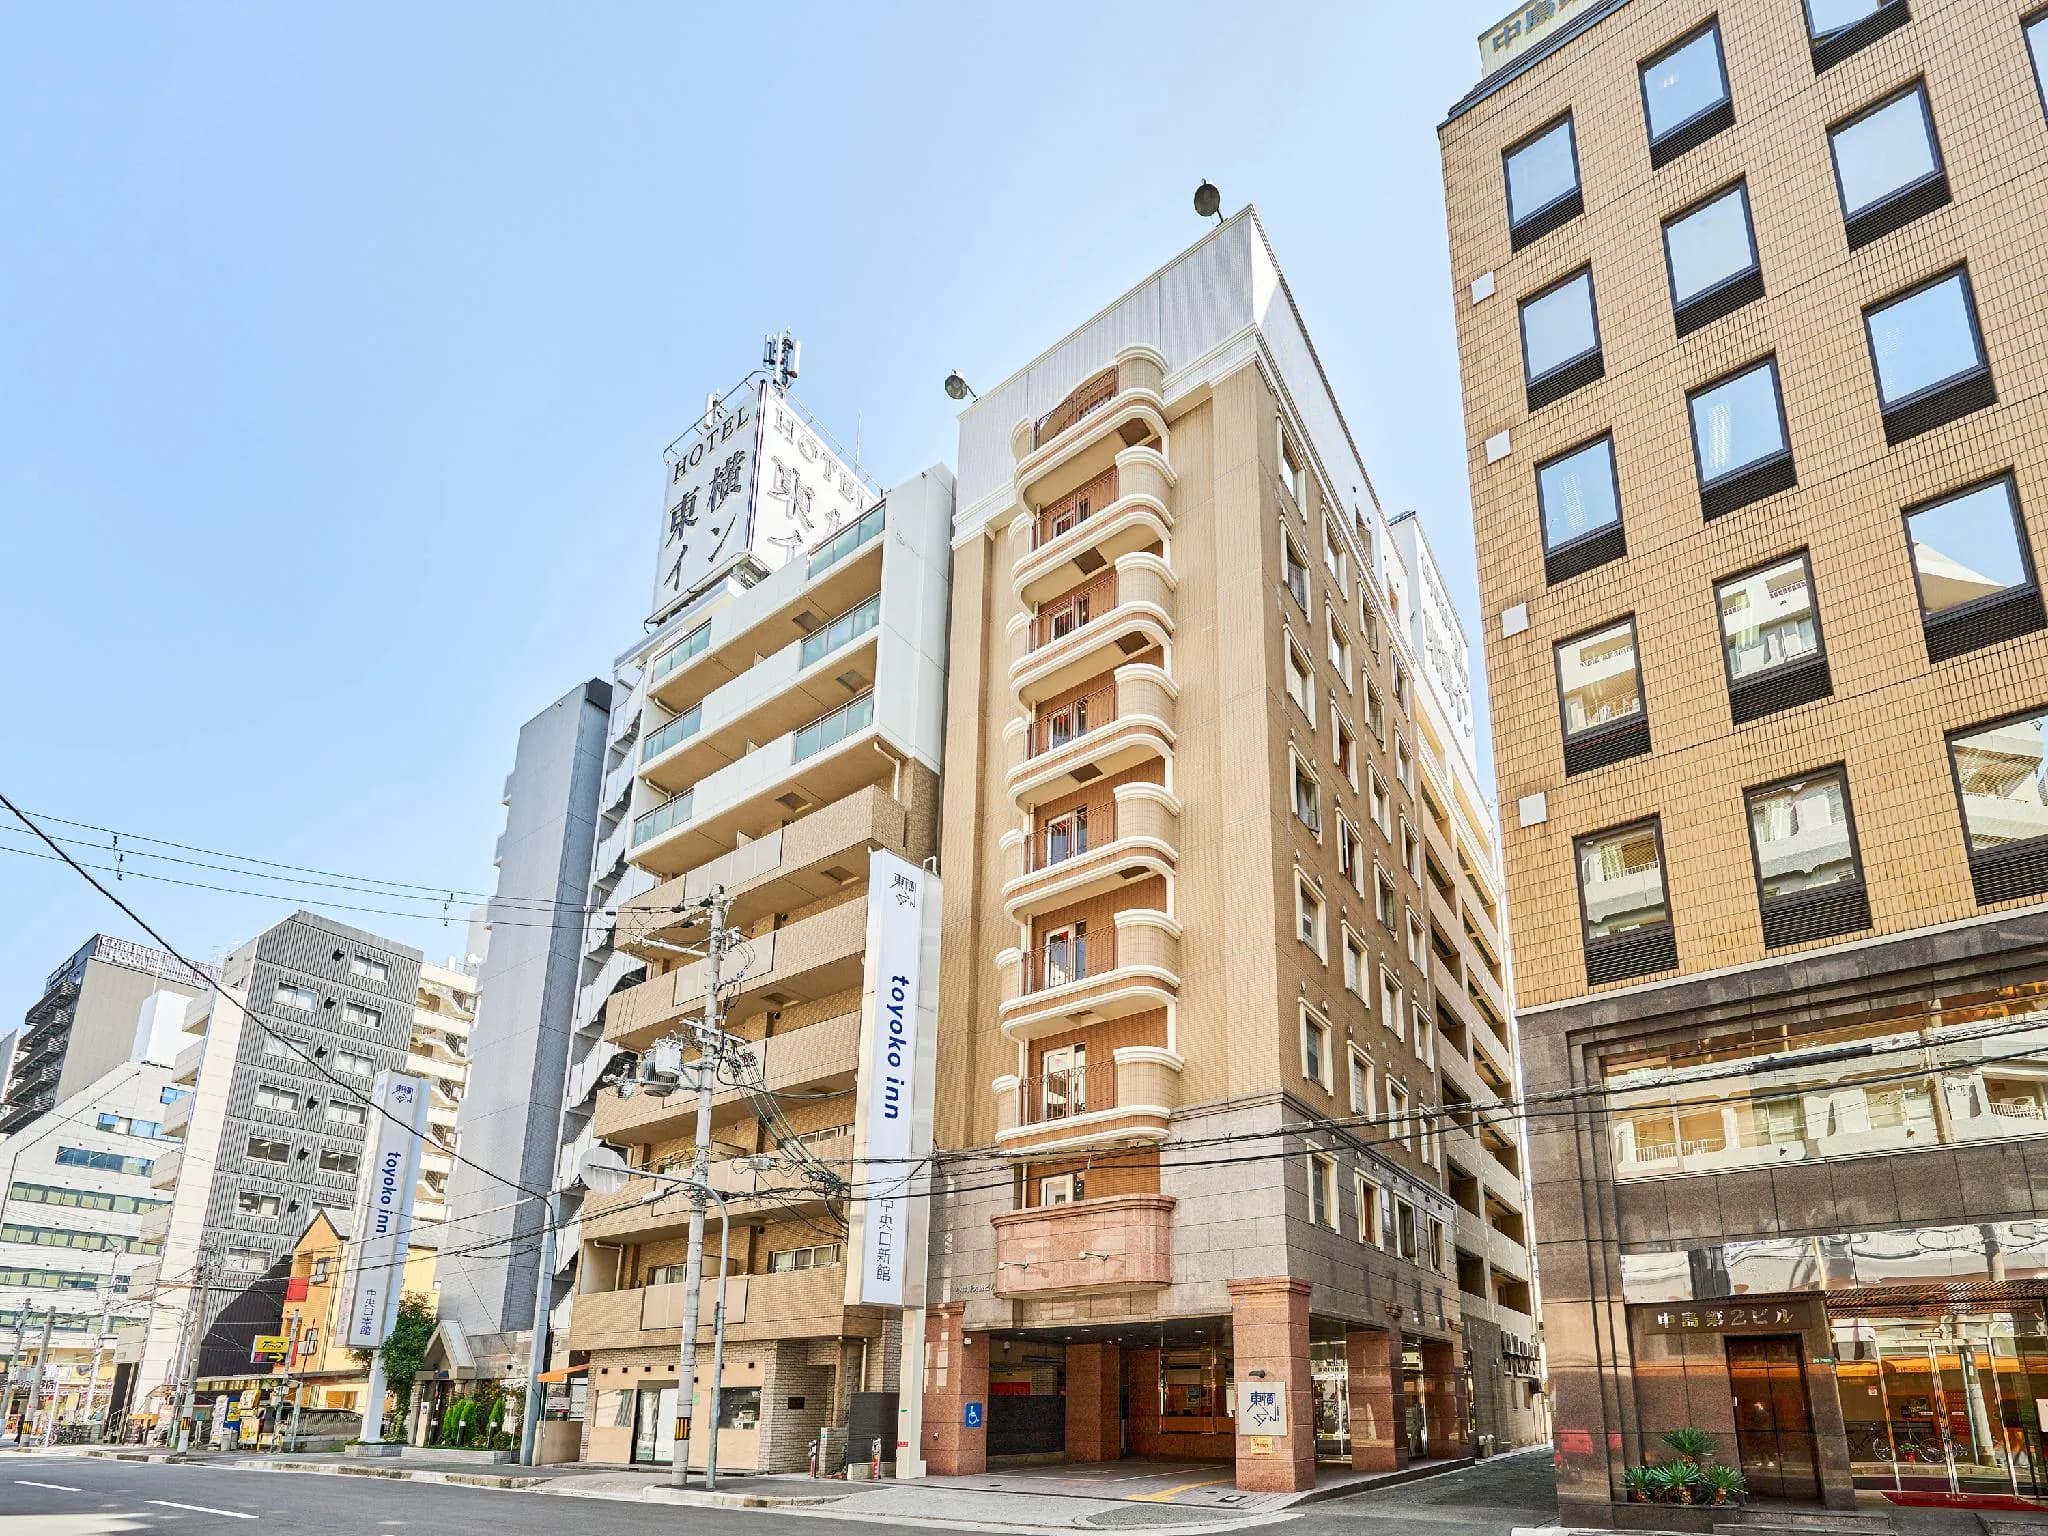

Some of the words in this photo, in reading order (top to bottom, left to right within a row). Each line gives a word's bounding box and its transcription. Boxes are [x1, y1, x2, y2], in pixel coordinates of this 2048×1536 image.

[672, 405, 750, 485] HOTEL
[887, 975, 910, 1067] toyoko
[884, 1076, 904, 1119] inn
[381, 1151, 401, 1204] toyoko
[376, 1208, 393, 1233] inn
[876, 1198, 894, 1282] 中央口新館
